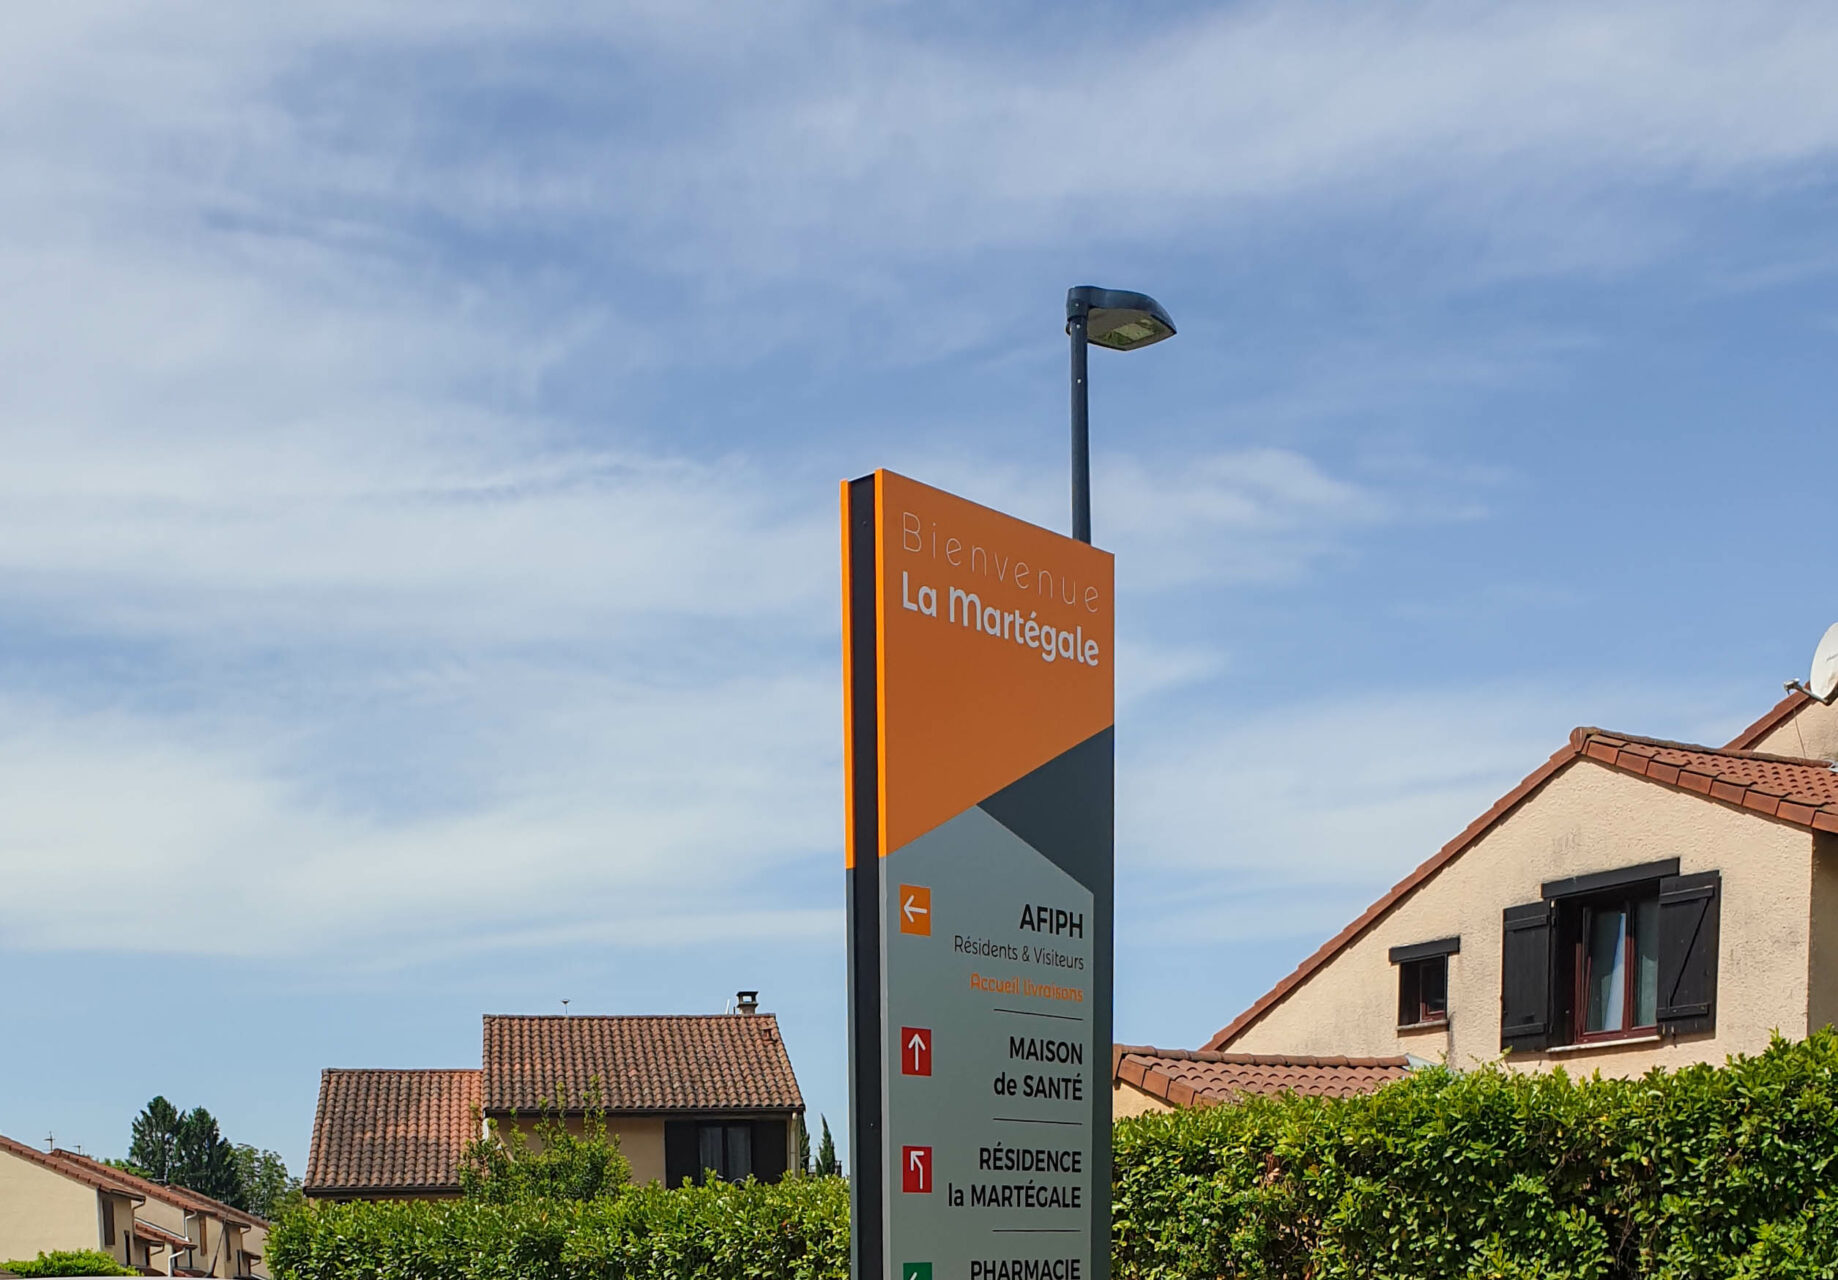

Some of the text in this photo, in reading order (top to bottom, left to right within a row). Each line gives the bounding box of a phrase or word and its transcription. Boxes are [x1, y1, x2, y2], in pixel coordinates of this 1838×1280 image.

[902, 511, 1099, 613] Bienvenue
[902, 571, 937, 617] La
[1019, 904, 1084, 939] AFIPH
[954, 935, 1085, 971] Résidents & Visiteurs
[970, 972, 1019, 995] Accueil
[1009, 1036, 1083, 1065] MAISON
[993, 1072, 1083, 1101] de SANTÉ
[979, 1142, 1082, 1173] RÉSIDENCE
[948, 1180, 1081, 1208] la MARTÉGALE
